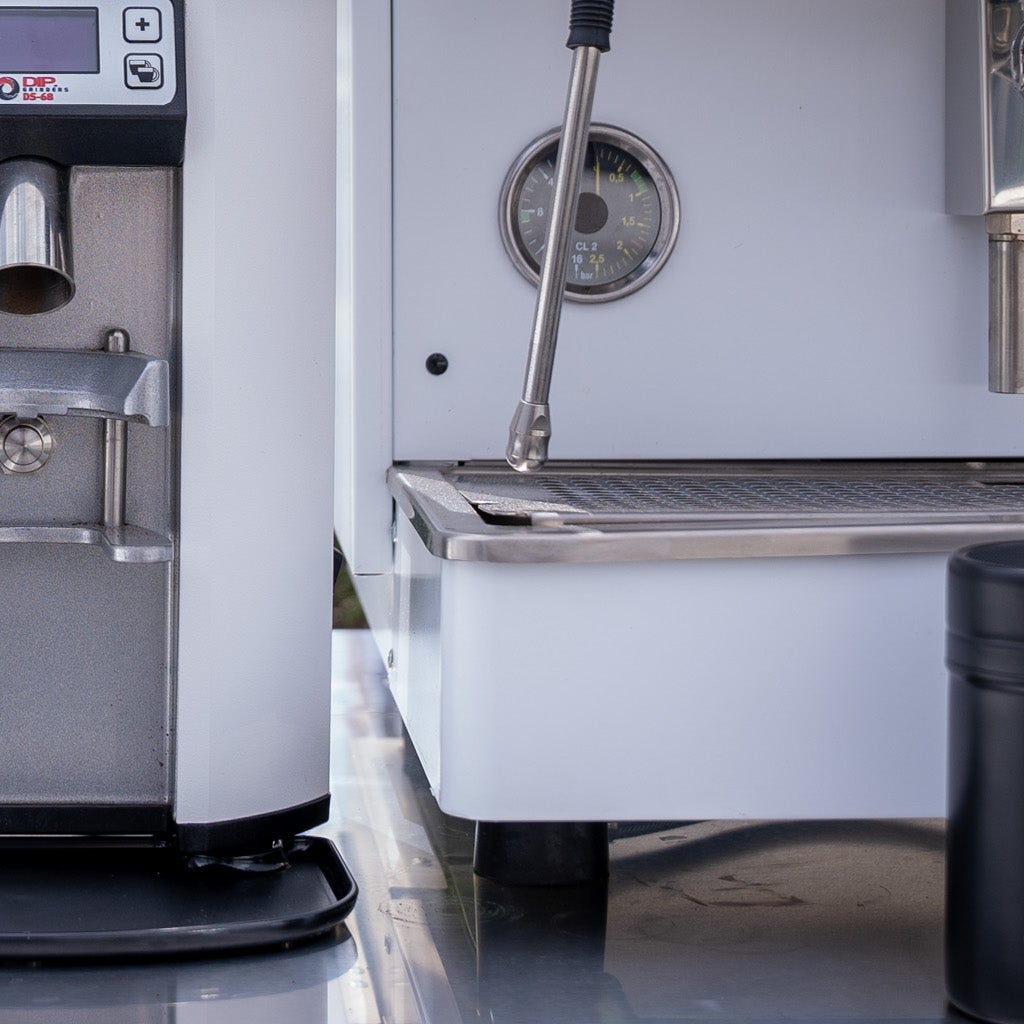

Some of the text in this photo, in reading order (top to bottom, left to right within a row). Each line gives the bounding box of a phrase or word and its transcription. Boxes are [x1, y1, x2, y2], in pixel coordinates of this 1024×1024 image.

[22, 77, 56, 87] DIP
[23, 93, 54, 101] DS-68
[547, 177, 554, 186] 4
[628, 192, 634, 203] 1
[537, 207, 544, 217] 8
[576, 241, 598, 251] CL 2
[616, 240, 624, 250] 2
[572, 254, 583, 264] 16
[580, 270, 593, 280] bar
